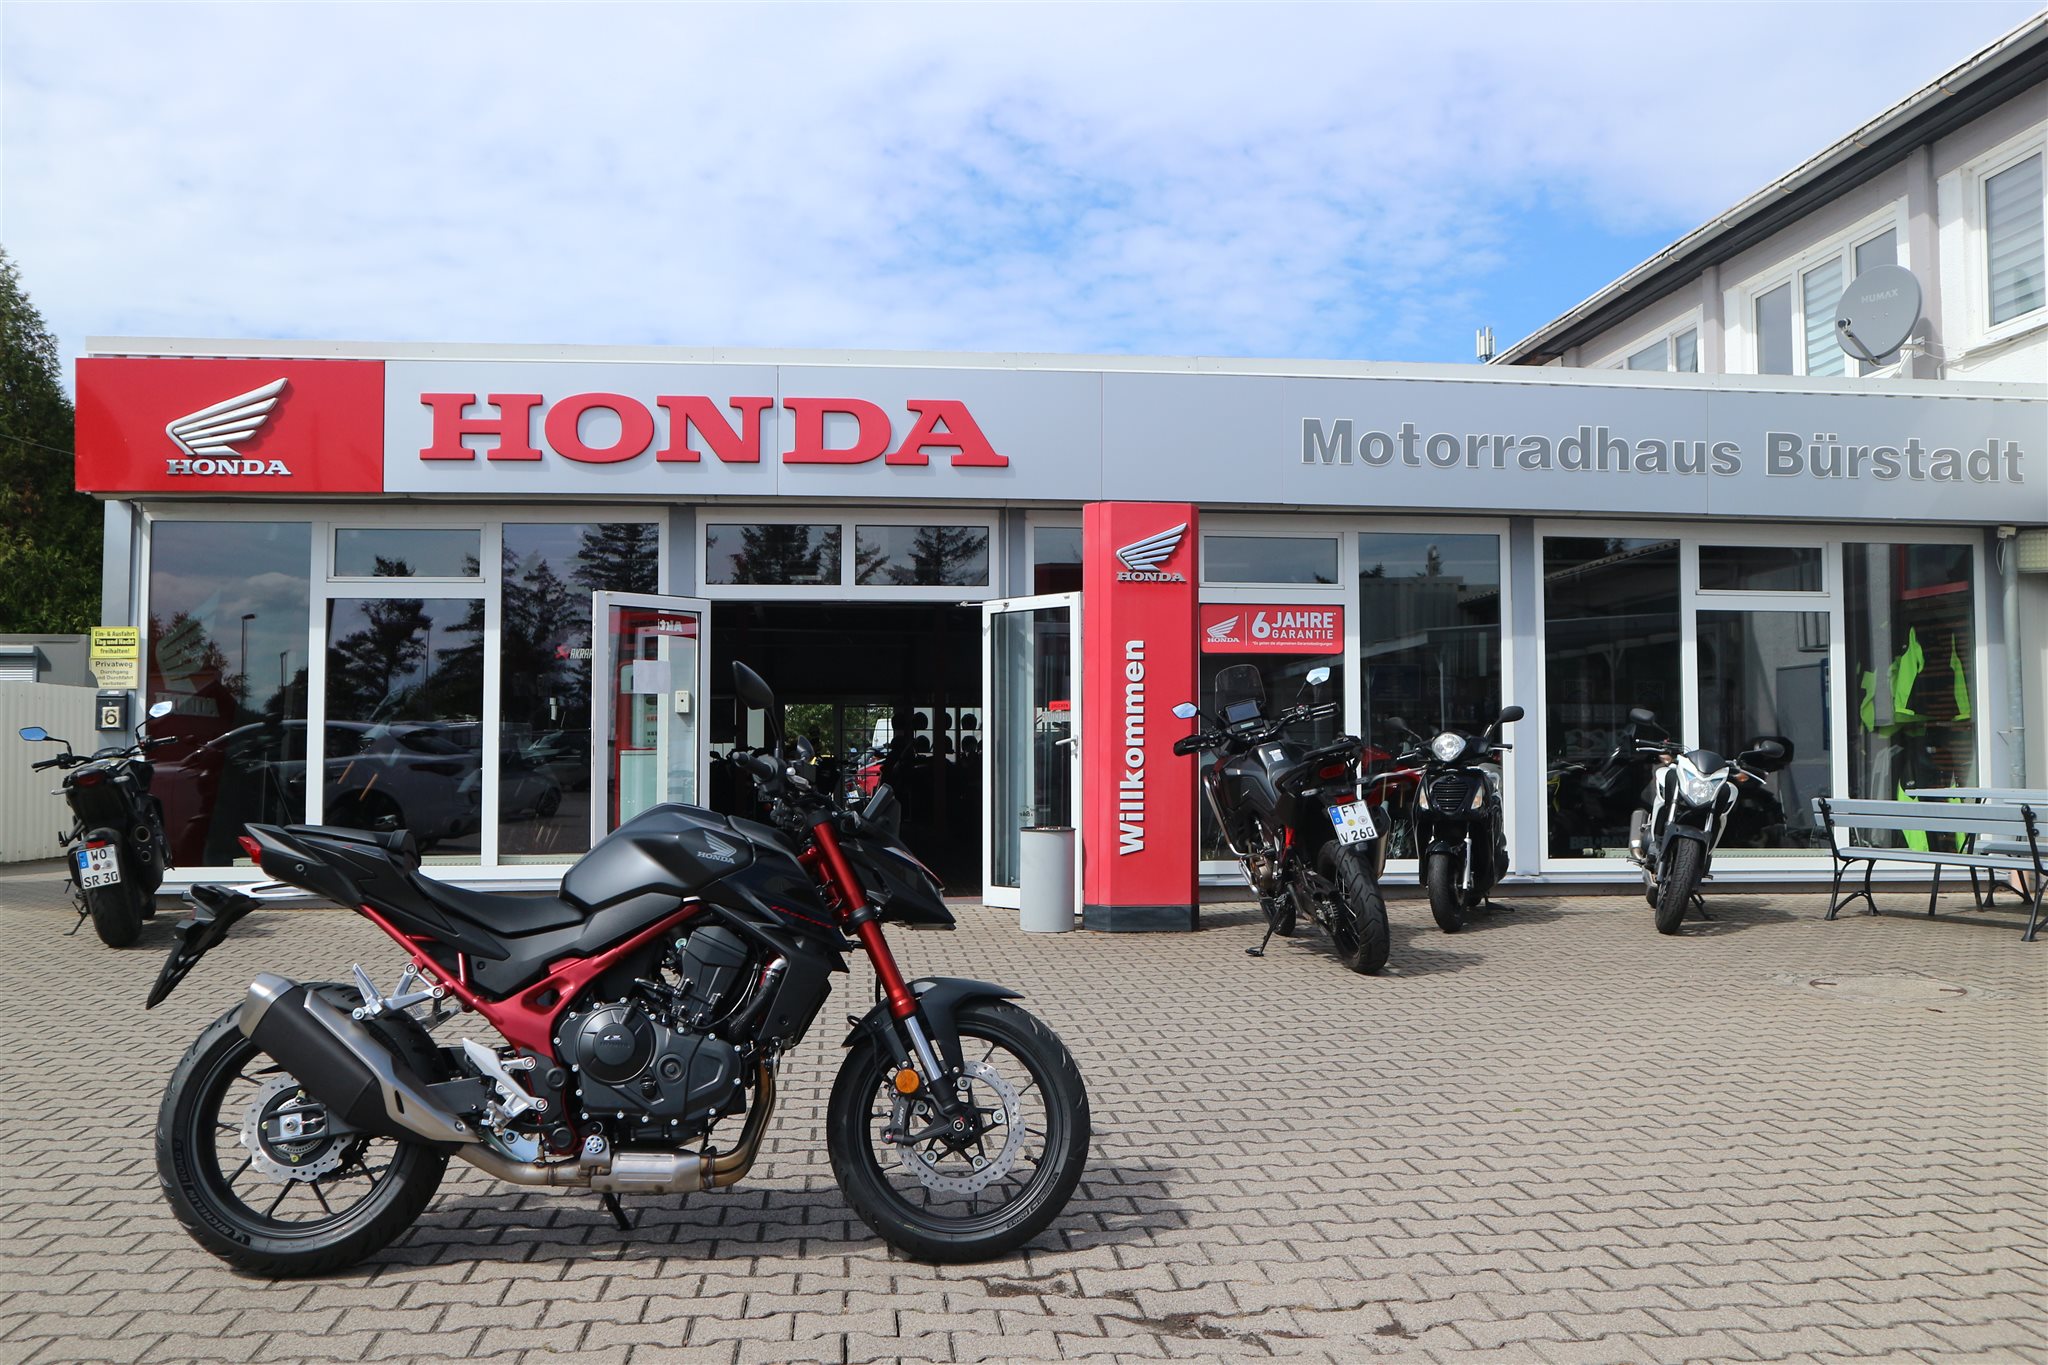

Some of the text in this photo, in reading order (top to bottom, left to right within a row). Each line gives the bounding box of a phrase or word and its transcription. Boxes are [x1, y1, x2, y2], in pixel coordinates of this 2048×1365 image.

[1861, 289, 1898, 304] HUMAX
[419, 392, 1009, 467] HONDA
[1300, 417, 2025, 484] Motorradhaus Bürstadt
[166, 459, 292, 475] HONDA
[1116, 571, 1186, 582] HONDA
[1251, 611, 1271, 639] 6
[1272, 630, 1334, 639] GARANTIE
[104, 709, 117, 725] 6
[1119, 640, 1145, 856] Willkommen
[1341, 804, 1357, 817] FT
[1340, 826, 1375, 843] V 260
[91, 849, 107, 861] WO
[697, 851, 736, 865] HONDA
[83, 871, 118, 888] SR 30
[187, 1189, 234, 1236] MICHELIN
